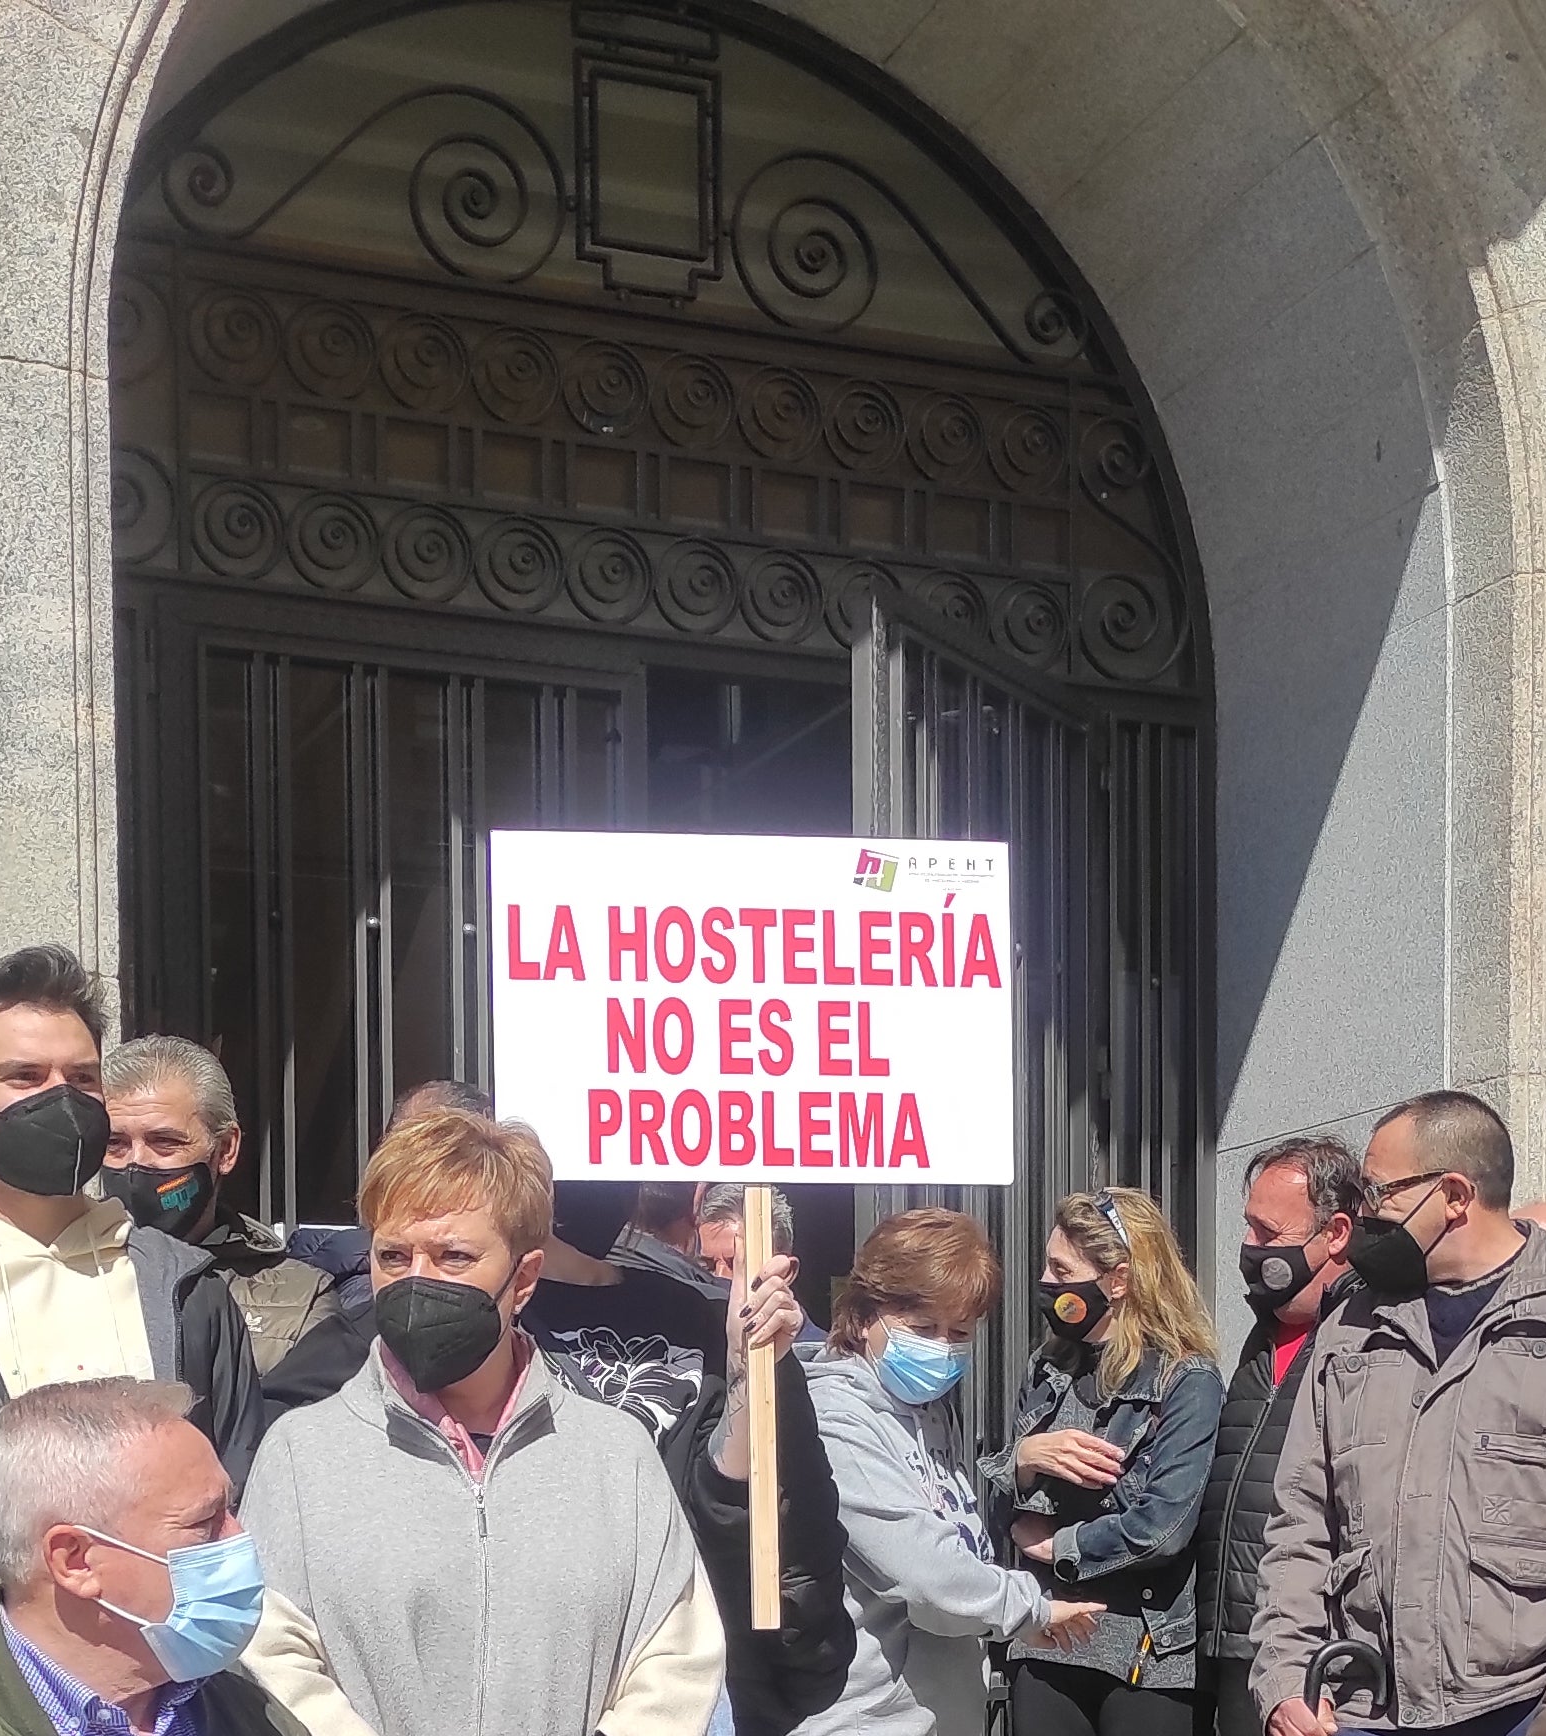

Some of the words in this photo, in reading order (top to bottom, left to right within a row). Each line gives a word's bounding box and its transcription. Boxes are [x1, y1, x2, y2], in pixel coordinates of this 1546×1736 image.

[908, 856, 994, 871] APEHT
[508, 904, 585, 981] LA
[608, 893, 1002, 988] HOSTELERÍA
[607, 997, 694, 1074] NO
[719, 999, 794, 1076] ES
[818, 1001, 890, 1076] EL
[588, 1089, 929, 1168] PROBLEMA
